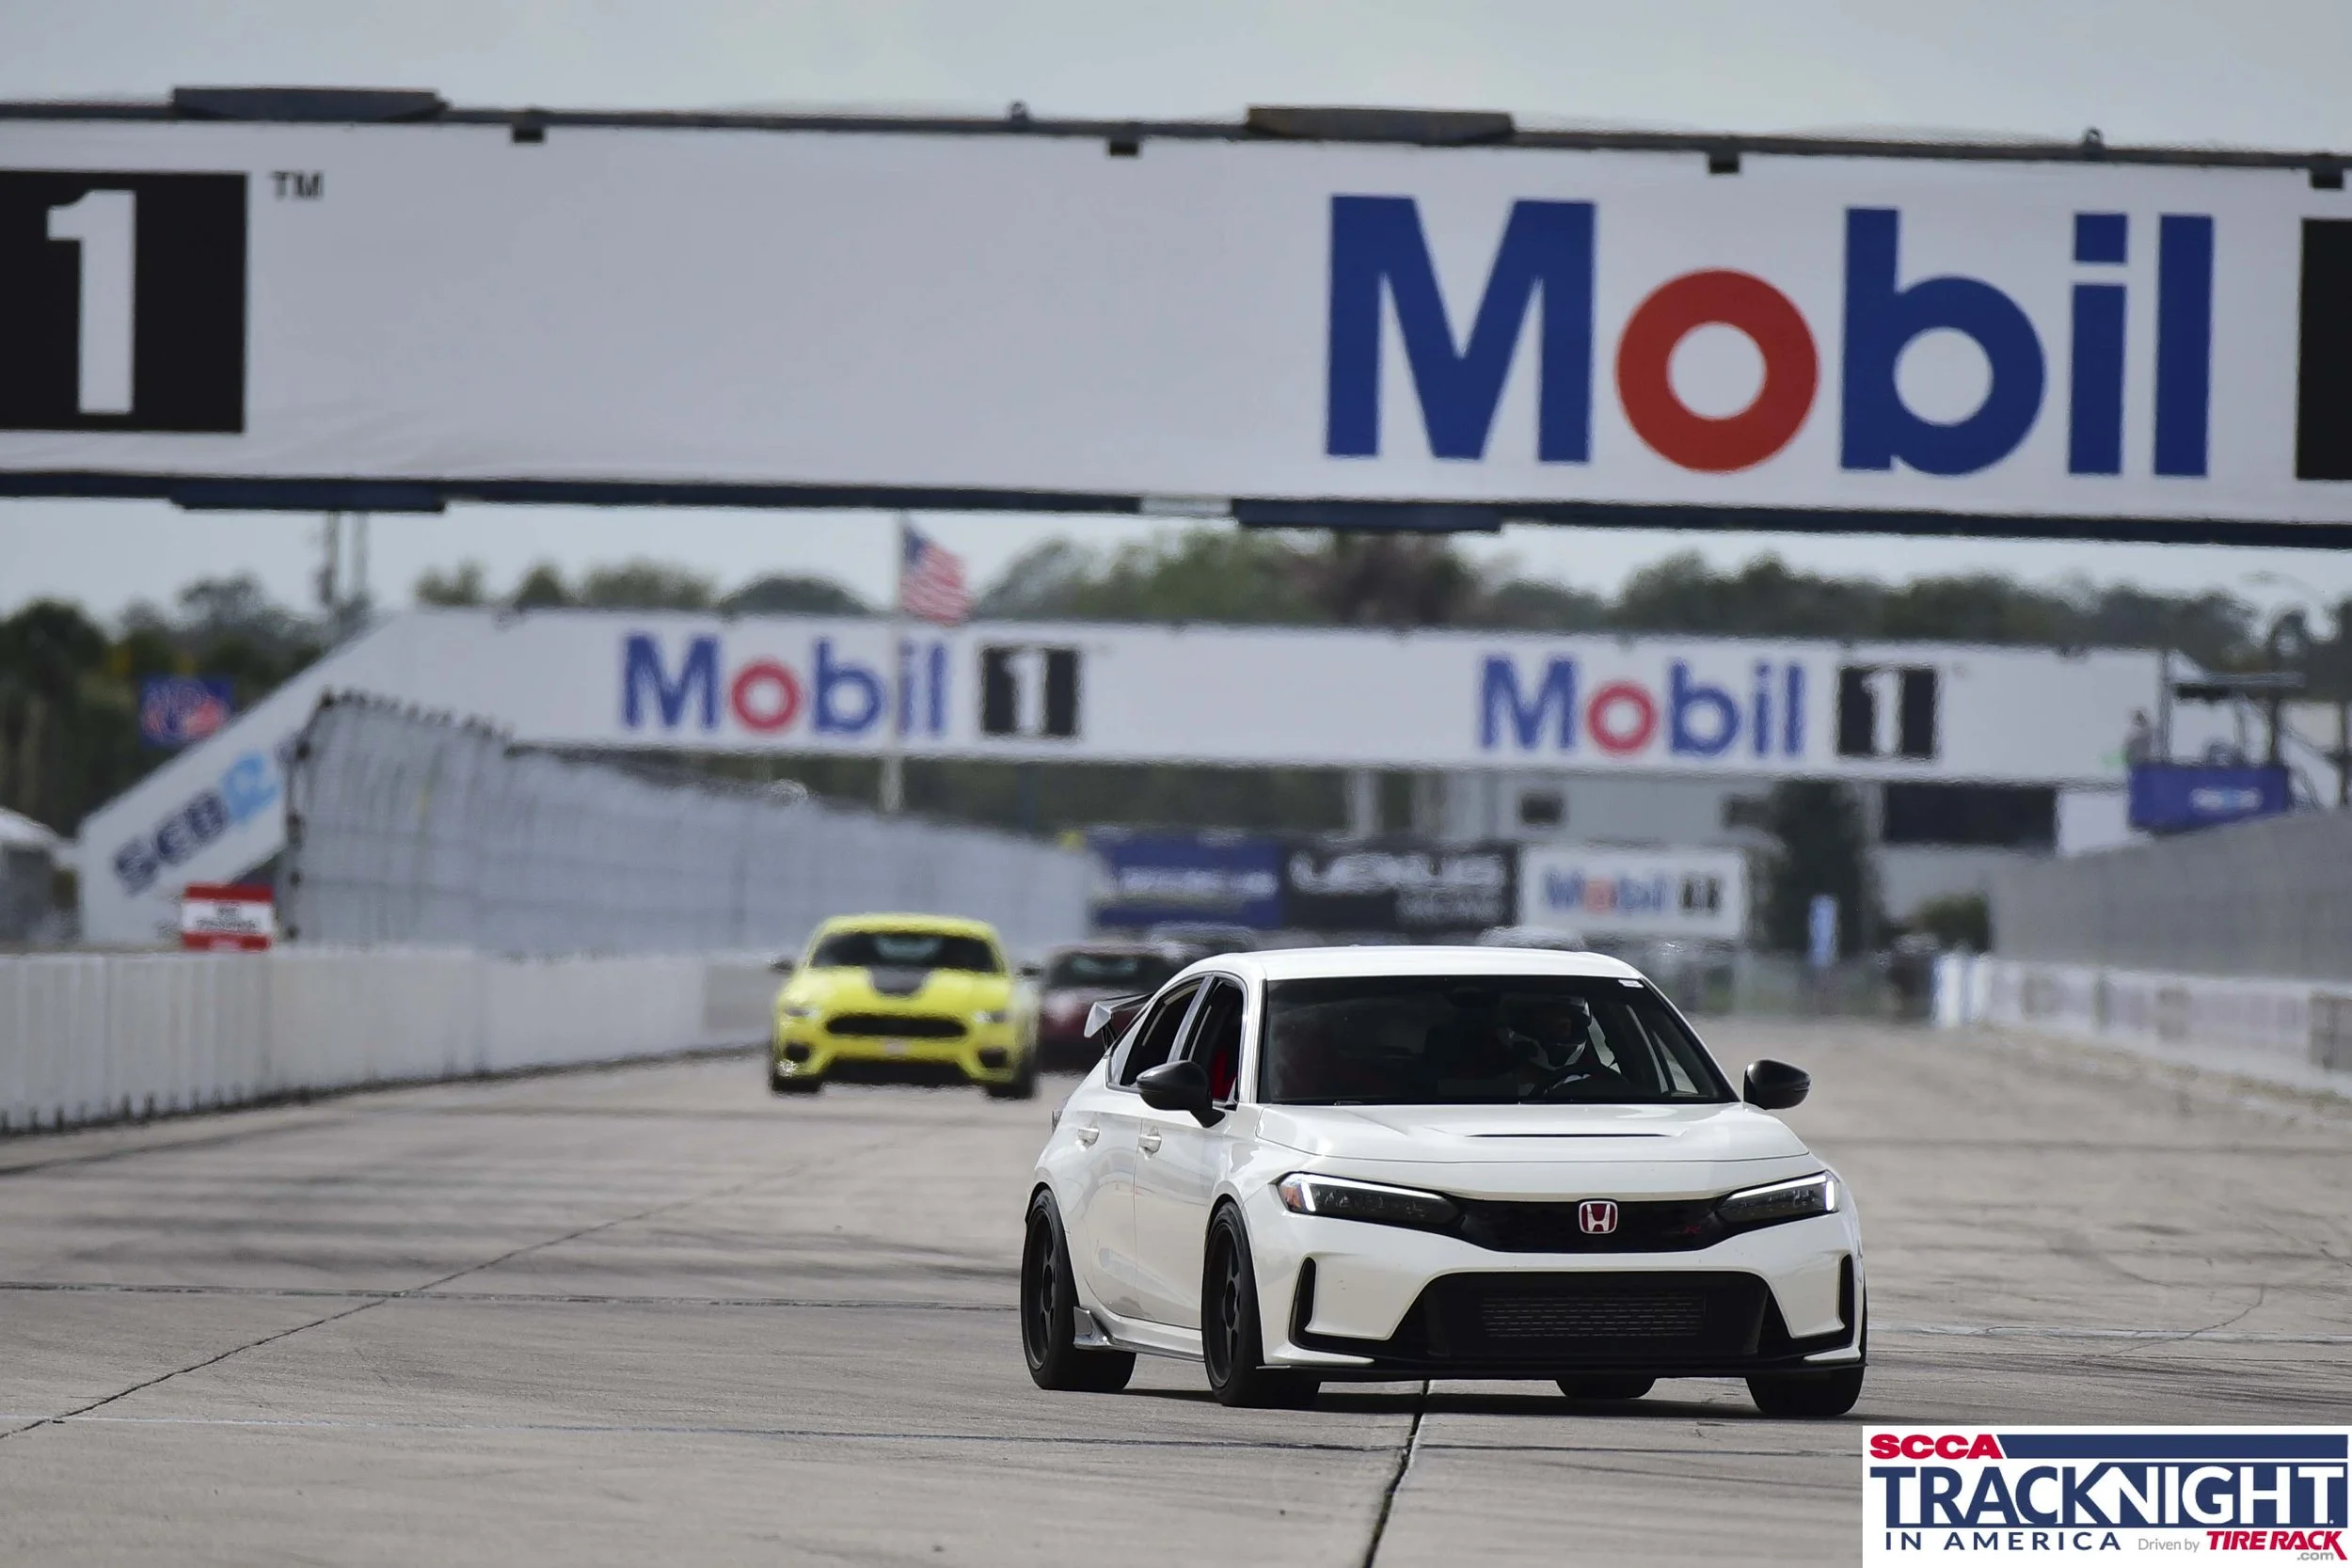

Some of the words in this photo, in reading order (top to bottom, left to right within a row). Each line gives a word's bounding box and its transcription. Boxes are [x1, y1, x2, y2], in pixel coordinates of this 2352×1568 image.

[46, 188, 137, 416] 1
[1326, 194, 2215, 478] Mobil
[621, 632, 950, 736] Mobil
[1001, 647, 1046, 736] 1
[1480, 653, 1805, 759] Mobil
[1860, 668, 1904, 756] 1
